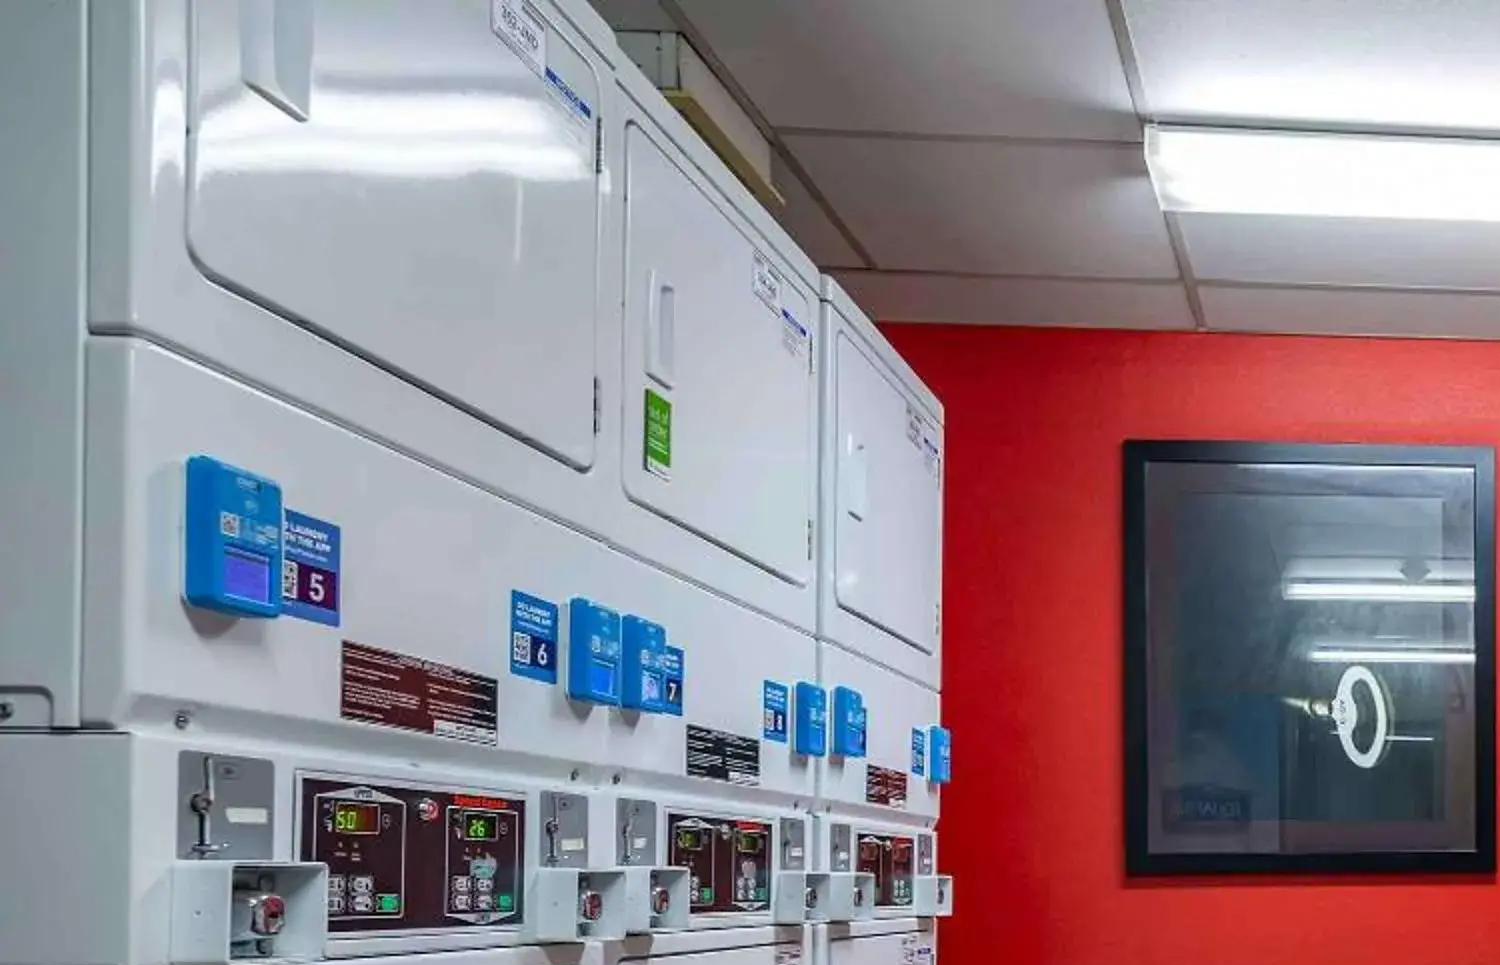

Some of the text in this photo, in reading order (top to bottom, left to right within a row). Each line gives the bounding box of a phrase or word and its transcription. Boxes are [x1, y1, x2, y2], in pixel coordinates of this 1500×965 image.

[308, 572, 325, 602] 5
[537, 643, 547, 666] 6
[669, 682, 677, 702] 7
